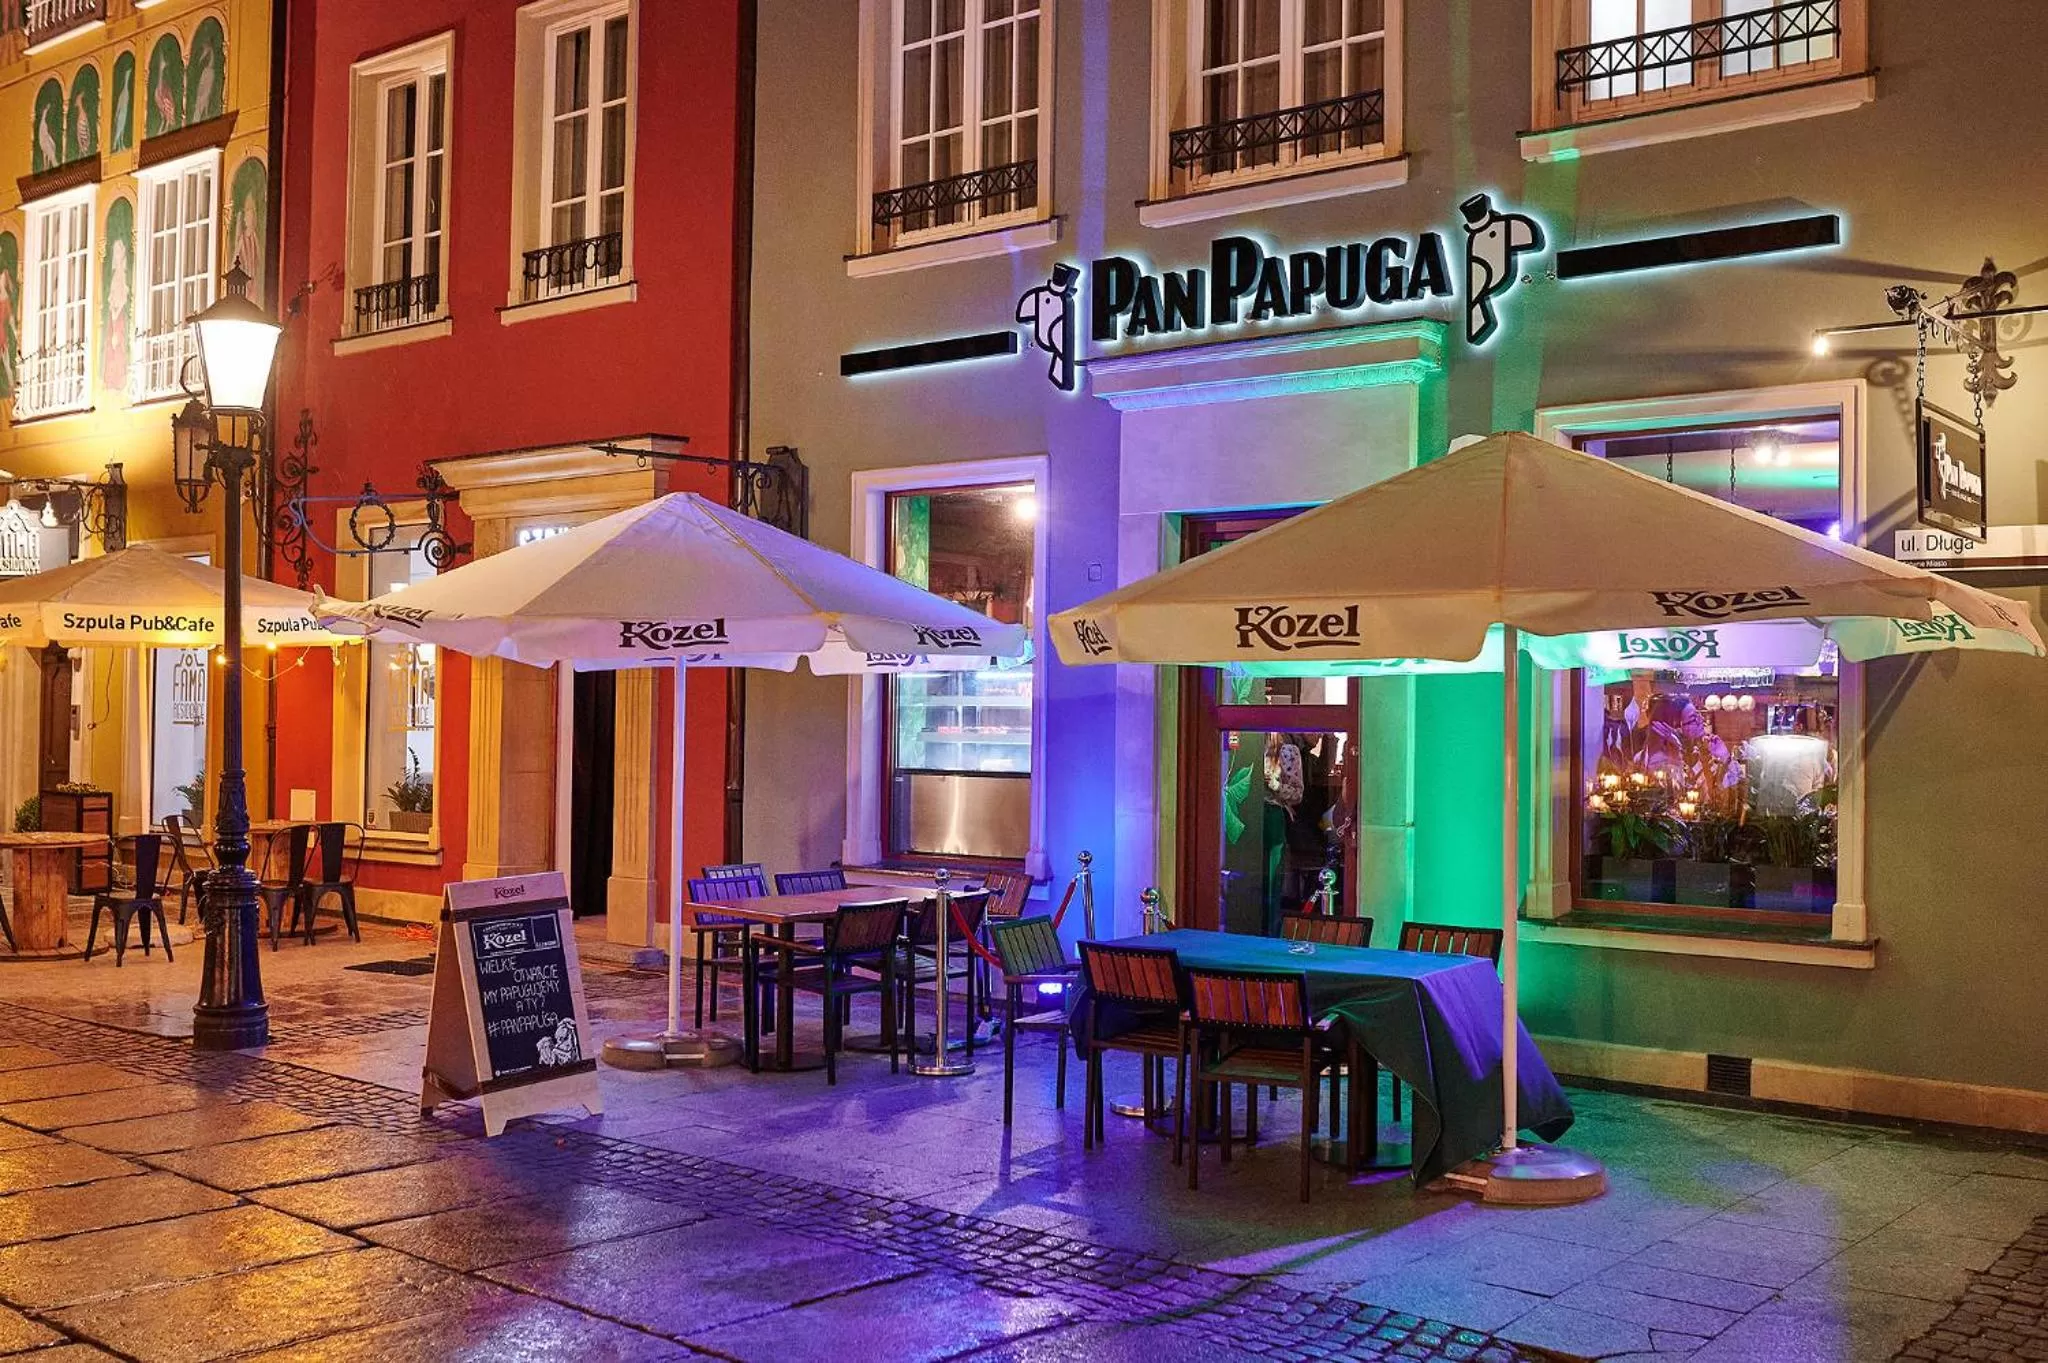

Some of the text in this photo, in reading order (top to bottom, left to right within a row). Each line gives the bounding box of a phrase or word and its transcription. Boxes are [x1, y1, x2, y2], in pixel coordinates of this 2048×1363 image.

[1091, 232, 1454, 342] PAN PAPUGA
[1901, 534, 1974, 555] ul. Długa
[1648, 586, 1809, 617] Kozel
[63, 612, 215, 633] Szpula Pub&Cafe
[257, 618, 300, 635] Szpula
[1235, 604, 1361, 651] Kozel
[619, 618, 729, 650] Kozel
[912, 623, 983, 648] Kozel
[493, 884, 526, 899] Kozel
[482, 929, 528, 950] Kozel
[483, 988, 498, 1006] MY
